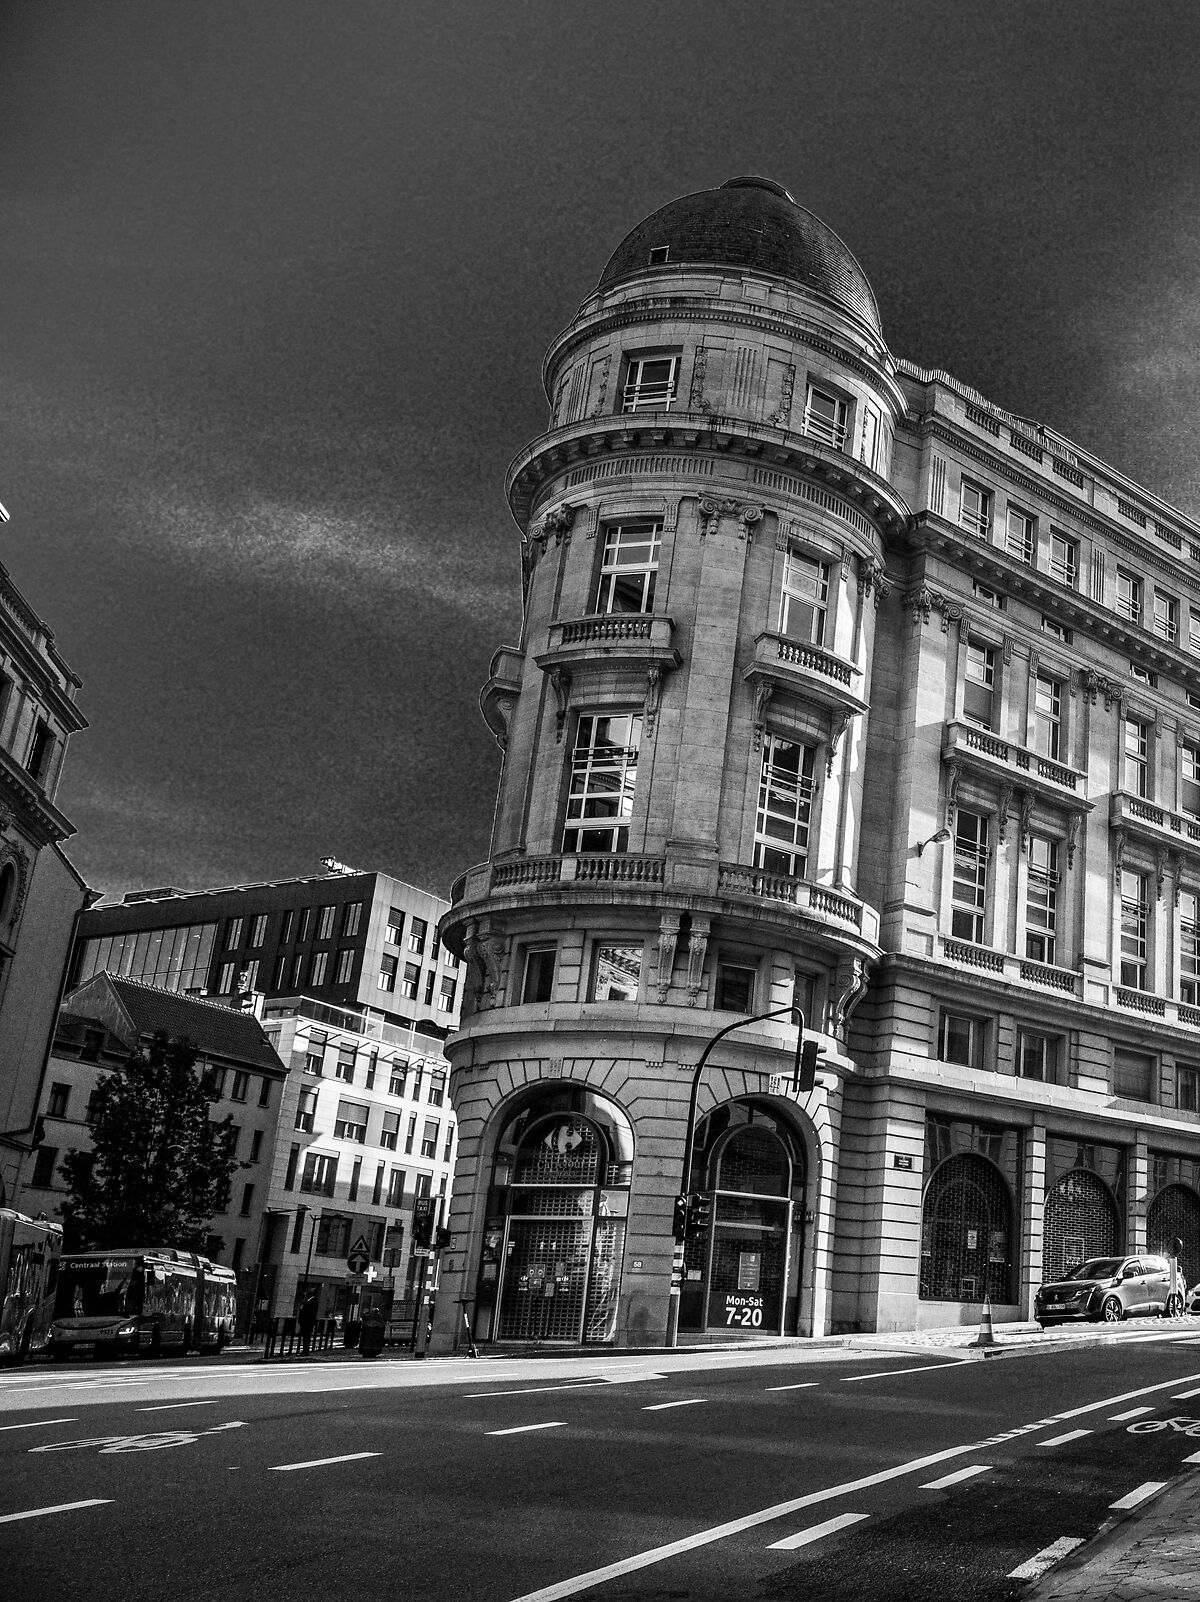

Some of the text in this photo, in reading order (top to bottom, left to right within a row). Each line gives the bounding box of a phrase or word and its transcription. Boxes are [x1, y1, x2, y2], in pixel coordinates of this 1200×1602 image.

[70, 1261, 100, 1269] Centraal
[725, 1295, 764, 1307] Mon-Sat
[725, 1306, 763, 1327] 7-20
